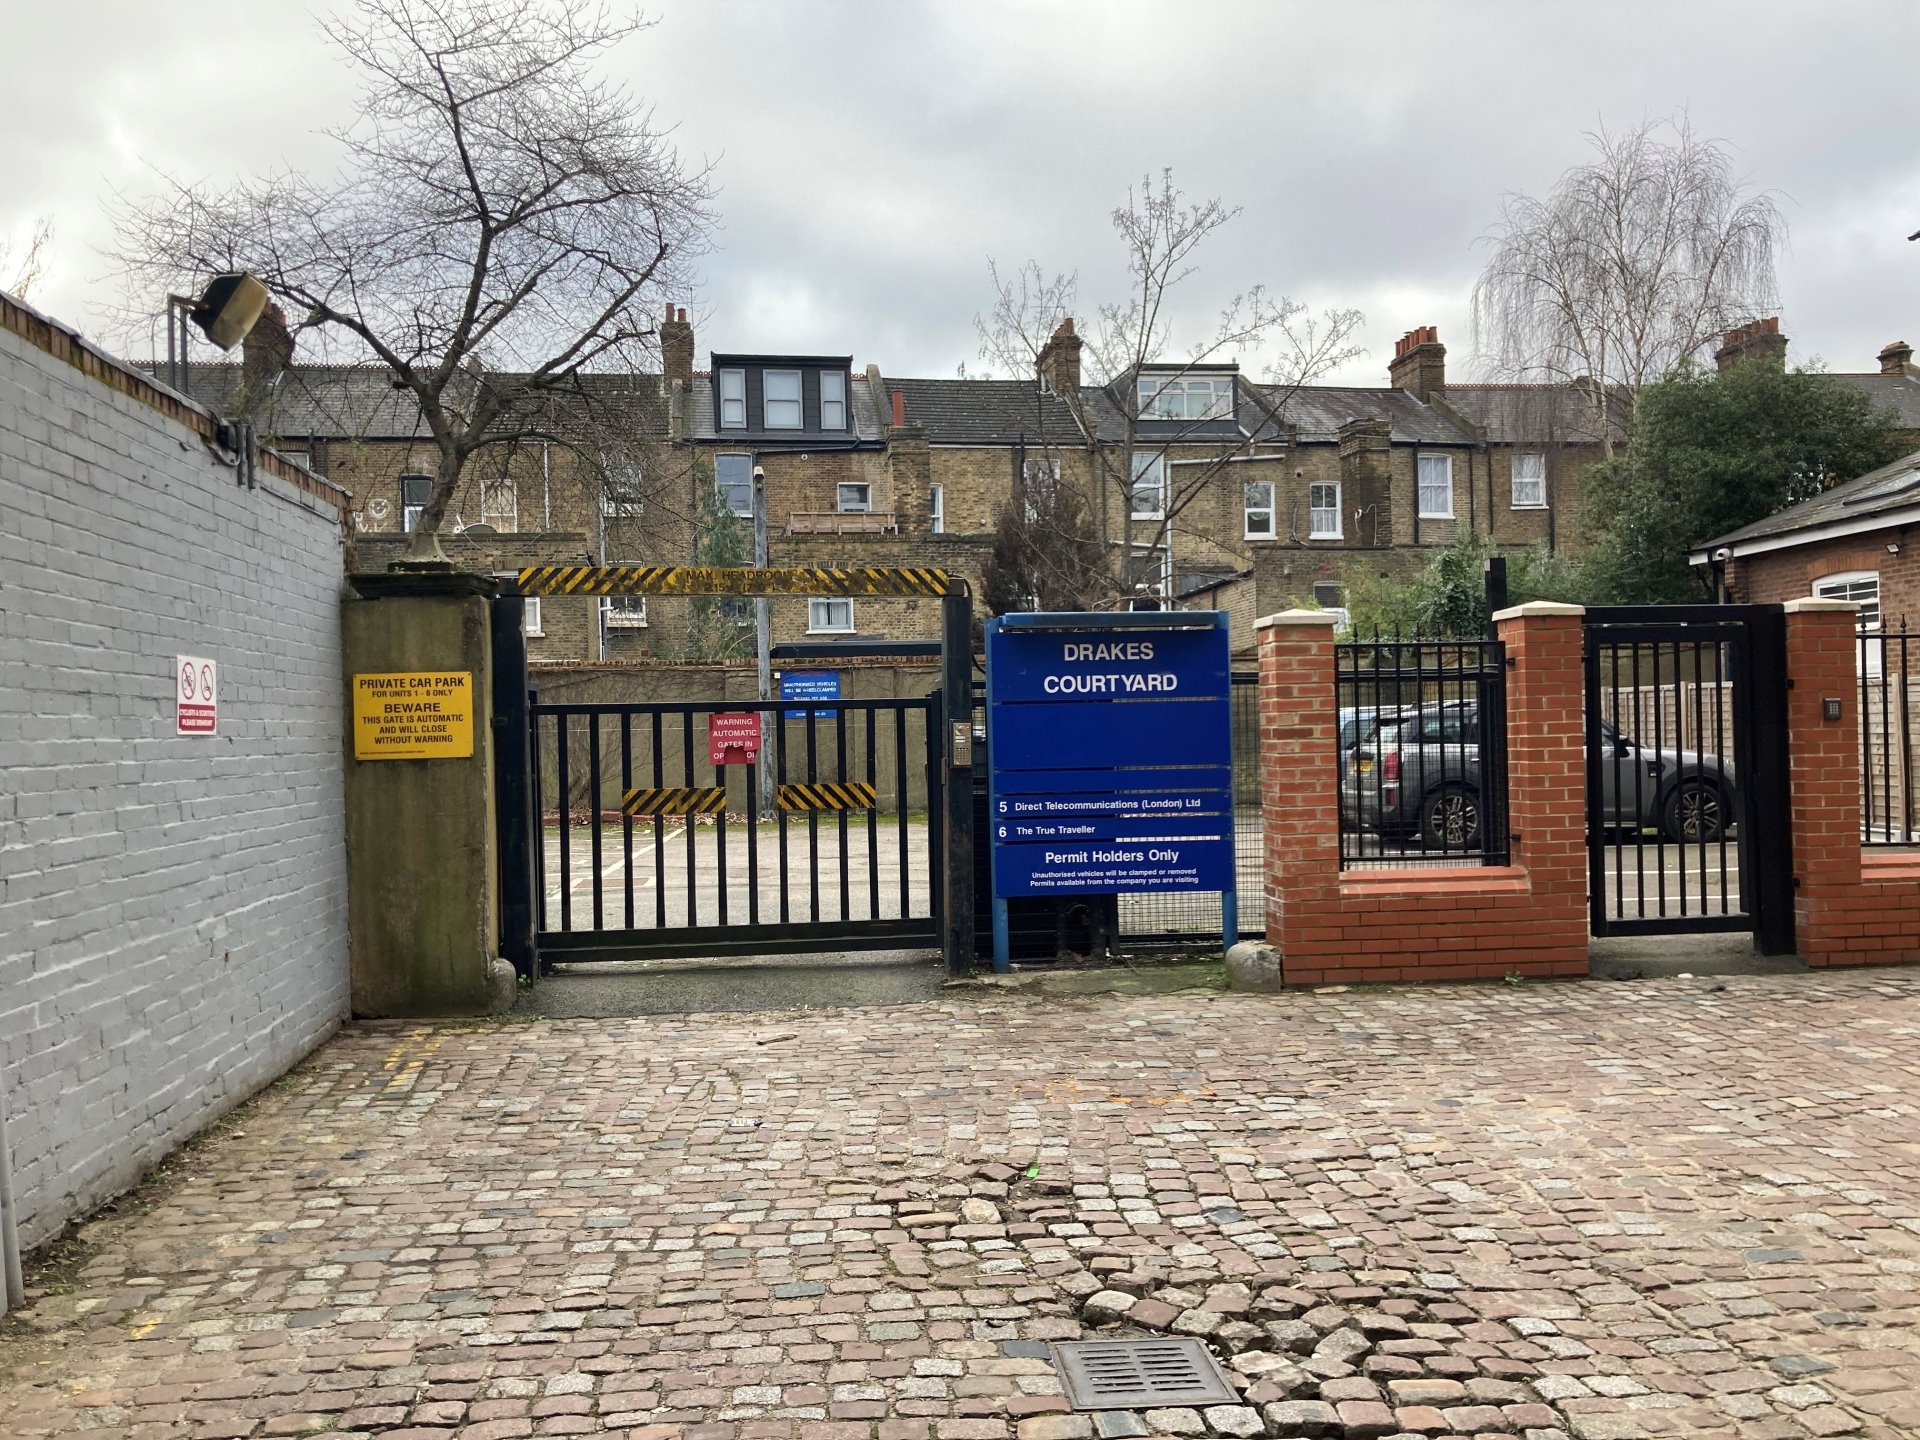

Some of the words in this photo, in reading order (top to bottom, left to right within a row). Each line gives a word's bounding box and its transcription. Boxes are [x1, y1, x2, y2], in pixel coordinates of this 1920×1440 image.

[1064, 643, 1154, 661] DRAKES
[360, 678, 406, 689] PRIVATE
[410, 678, 432, 688] CAR
[435, 677, 464, 687] PARK
[1043, 674, 1178, 693] COURTYARD
[372, 690, 388, 698] FOR
[384, 703, 441, 713] BEWARE
[363, 716, 381, 724] THIS
[406, 715, 414, 723] IS
[417, 714, 464, 723] AUTOMATIC
[716, 718, 753, 726] WARNING
[379, 726, 396, 734] AND
[399, 725, 419, 734] WILL
[713, 729, 757, 737] AUTOMATIC
[374, 736, 412, 744] WITHOUT
[414, 735, 453, 743] WARNING
[999, 801, 1008, 813] 5
[1015, 802, 1043, 811] Direct
[1046, 800, 1139, 810] Telecommunications
[1141, 799, 1183, 810] (London)
[1186, 799, 1201, 808] Ltd
[998, 826, 1007, 838] 6
[1016, 827, 1033, 835] The
[1035, 826, 1055, 835] True
[1058, 825, 1096, 834] Traveller
[1045, 851, 1088, 864] Permit
[1092, 850, 1144, 863] Holders
[1149, 849, 1179, 863] Only
[1031, 871, 1076, 879] Unauthorised
[1116, 878, 1147, 886] company
[1174, 876, 1199, 884] visiting
